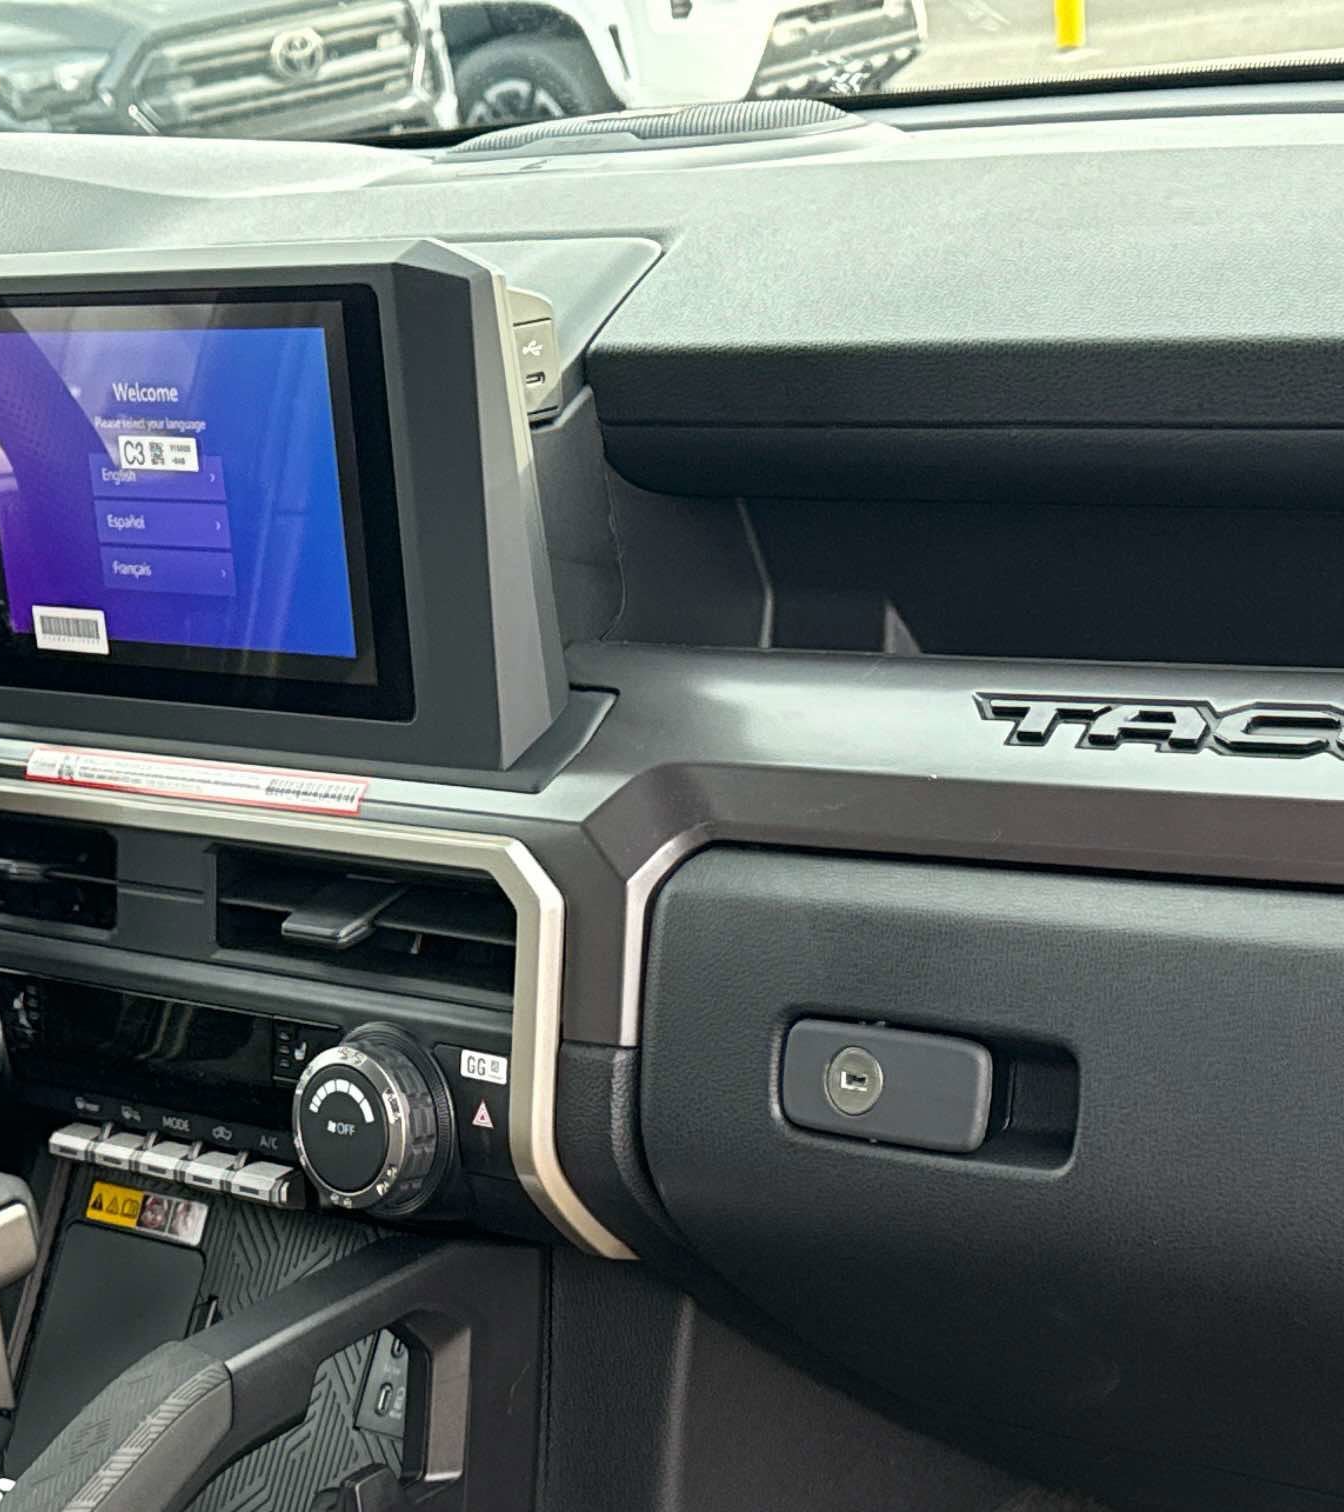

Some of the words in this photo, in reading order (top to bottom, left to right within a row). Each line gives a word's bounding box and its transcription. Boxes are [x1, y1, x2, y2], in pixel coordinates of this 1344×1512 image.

[112, 381, 179, 402] Welcome
[165, 416, 207, 433] language
[123, 440, 146, 466] C3
[101, 467, 136, 486] English
[106, 513, 145, 531] Español
[112, 560, 152, 579] Français
[467, 1055, 486, 1076] GG
[162, 1116, 191, 1132] MODE
[337, 1122, 355, 1137] OFF
[259, 1136, 278, 1150] A/C
